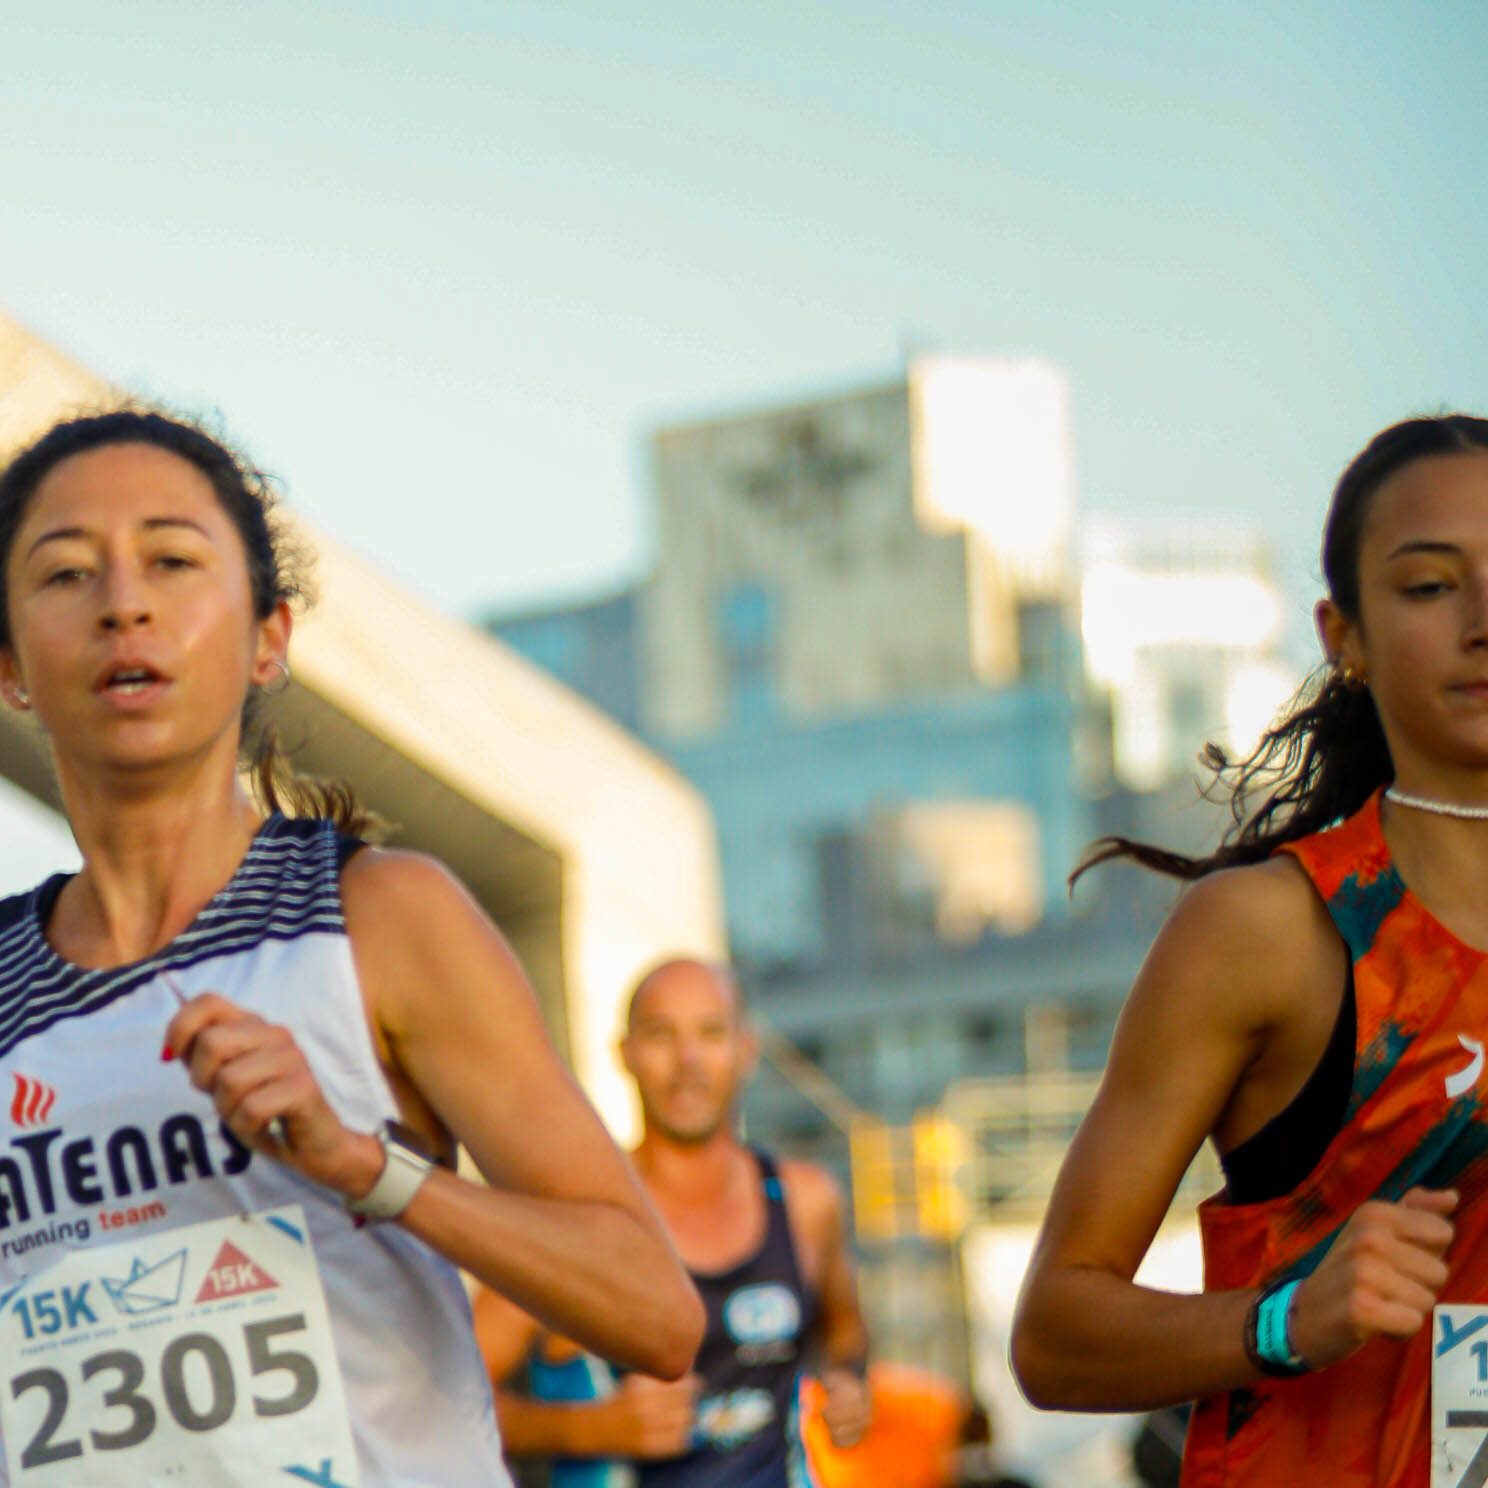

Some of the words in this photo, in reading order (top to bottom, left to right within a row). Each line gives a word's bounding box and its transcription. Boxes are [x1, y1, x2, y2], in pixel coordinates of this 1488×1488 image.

[0, 1217, 91, 1259] running
[98, 1199, 167, 1232] team
[211, 1260, 261, 1293] 15K
[12, 1280, 99, 1339] 15K
[9, 1311, 320, 1471] 2305
